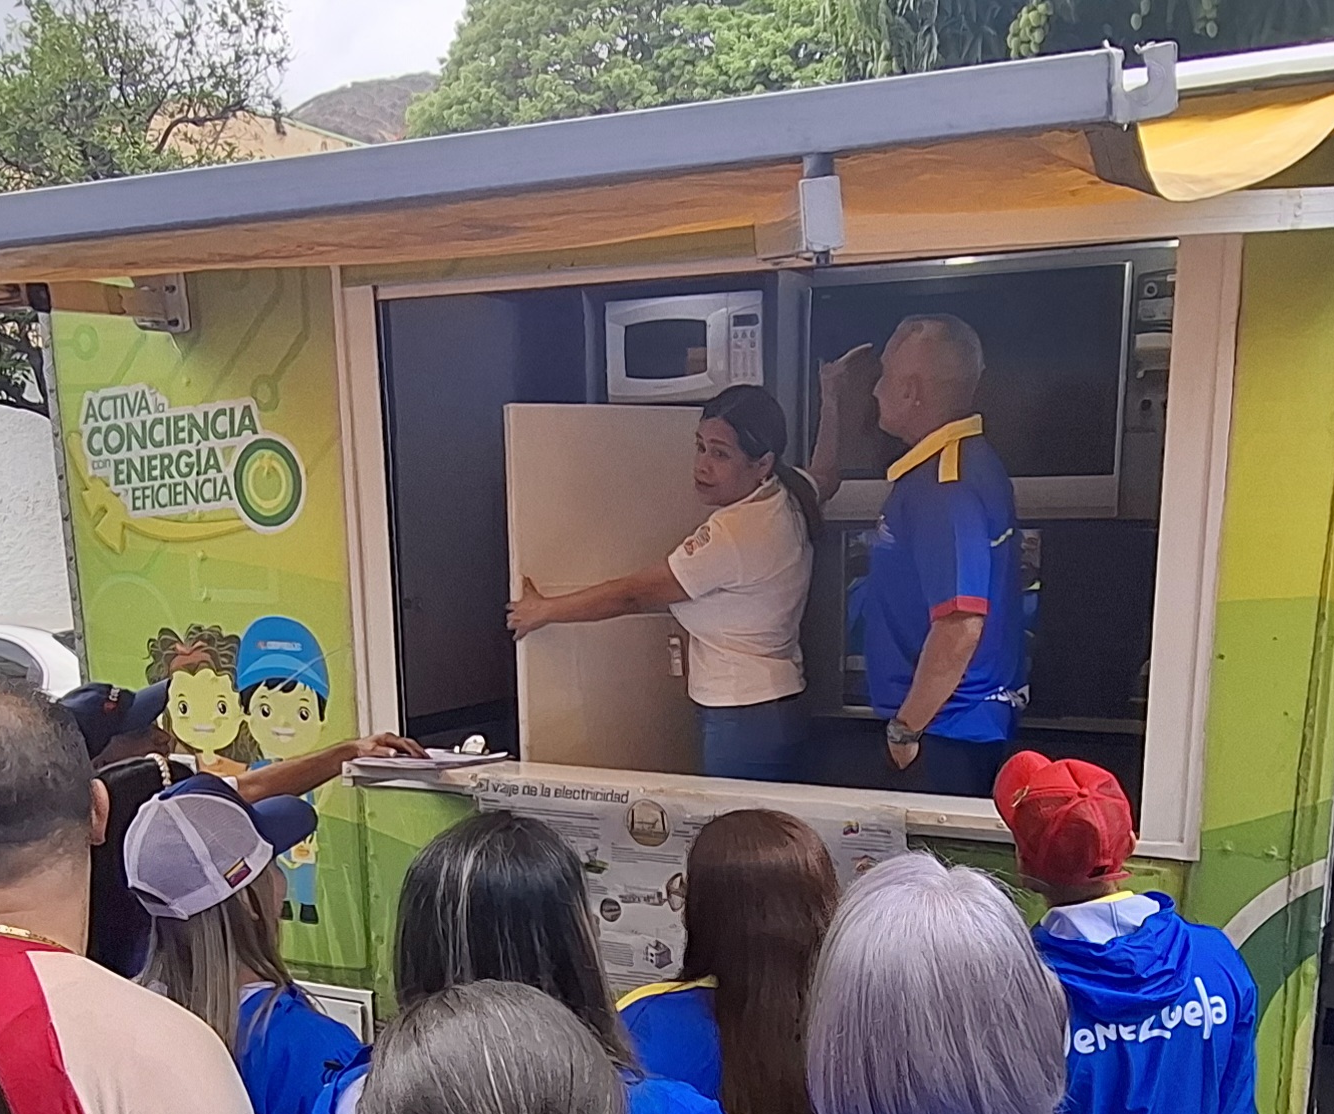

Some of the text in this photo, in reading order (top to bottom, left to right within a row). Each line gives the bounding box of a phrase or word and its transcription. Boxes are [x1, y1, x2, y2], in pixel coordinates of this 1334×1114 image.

[84, 389, 152, 425] ACTIVA
[86, 404, 259, 457] CONCIENCIA
[113, 440, 222, 486] ENERGÍA
[131, 475, 234, 511] EFICIENCIA
[554, 784, 630, 803] electricidad
